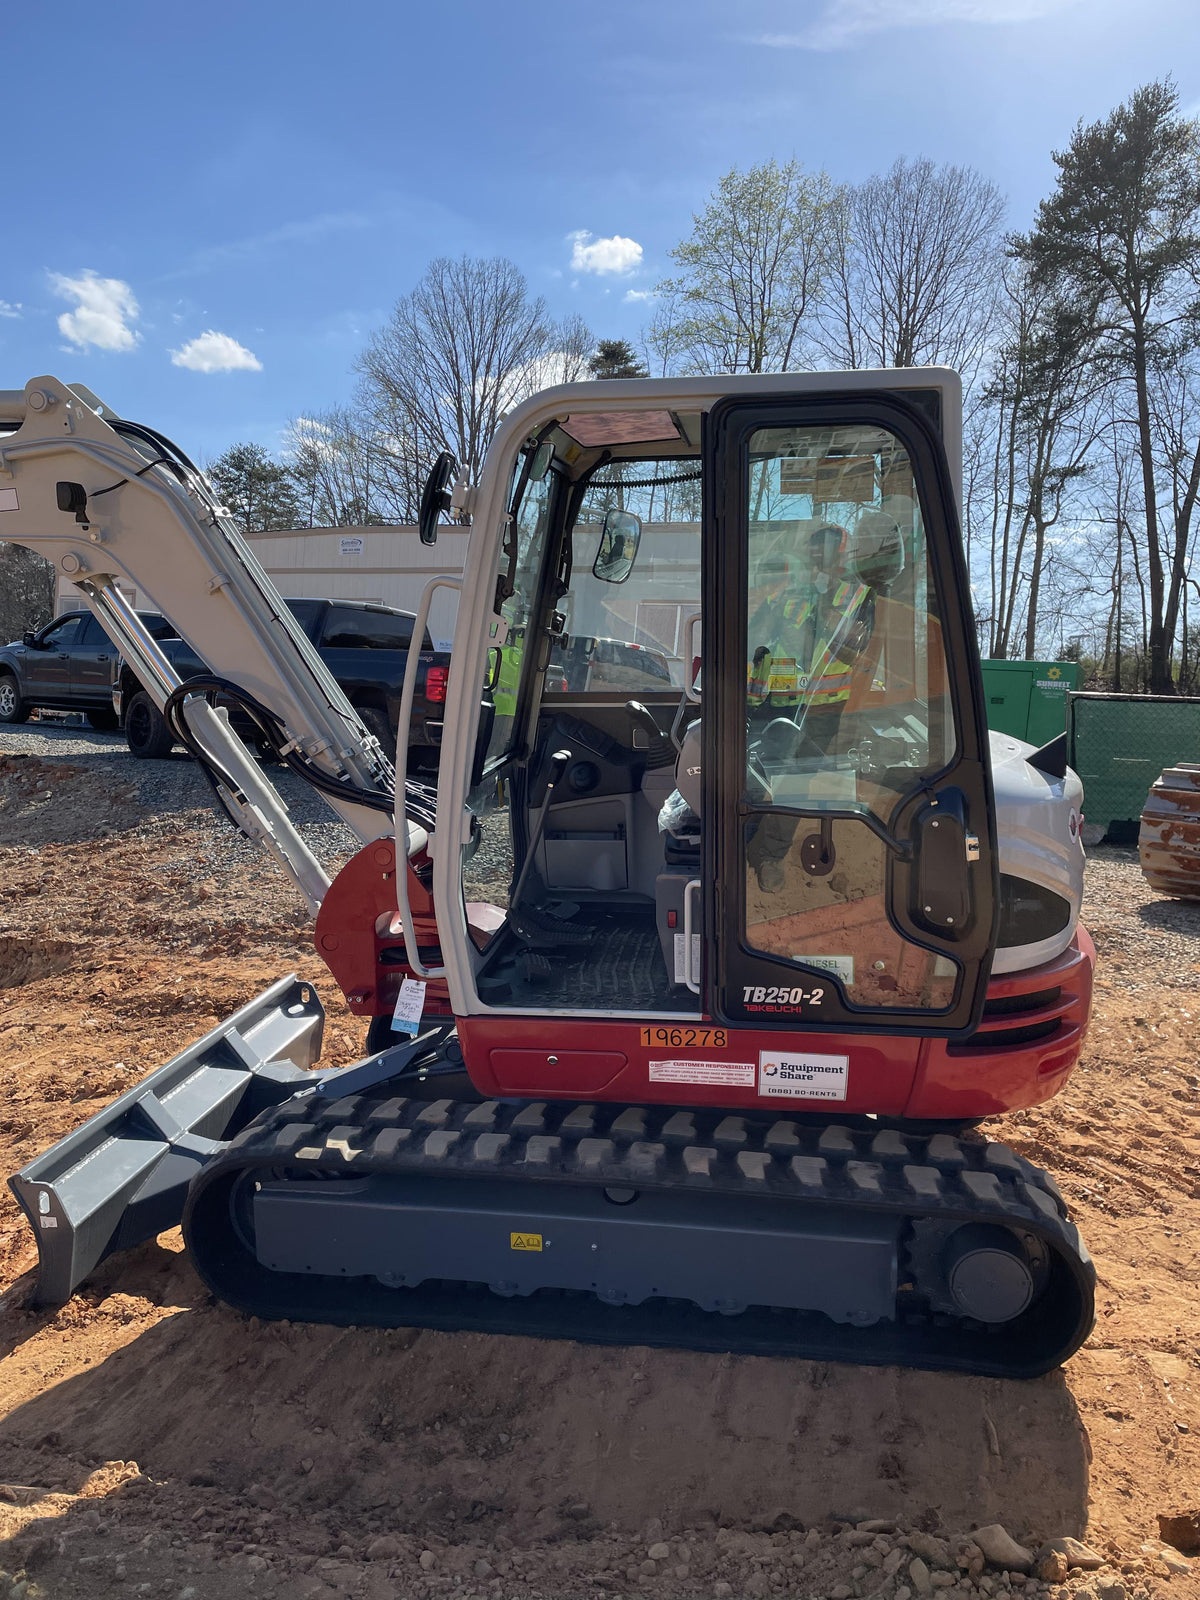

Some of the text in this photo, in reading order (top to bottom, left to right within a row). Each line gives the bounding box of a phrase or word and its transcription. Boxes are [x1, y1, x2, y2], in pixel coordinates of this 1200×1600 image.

[1036, 680, 1071, 688] SUNBELT
[805, 959, 840, 969] DIESEL
[743, 986, 824, 1005] TB250-2
[643, 1028, 726, 1047] 196278
[673, 1061, 705, 1069] CUSTOMER
[780, 1062, 844, 1074] Equipment
[780, 1071, 814, 1080] Share
